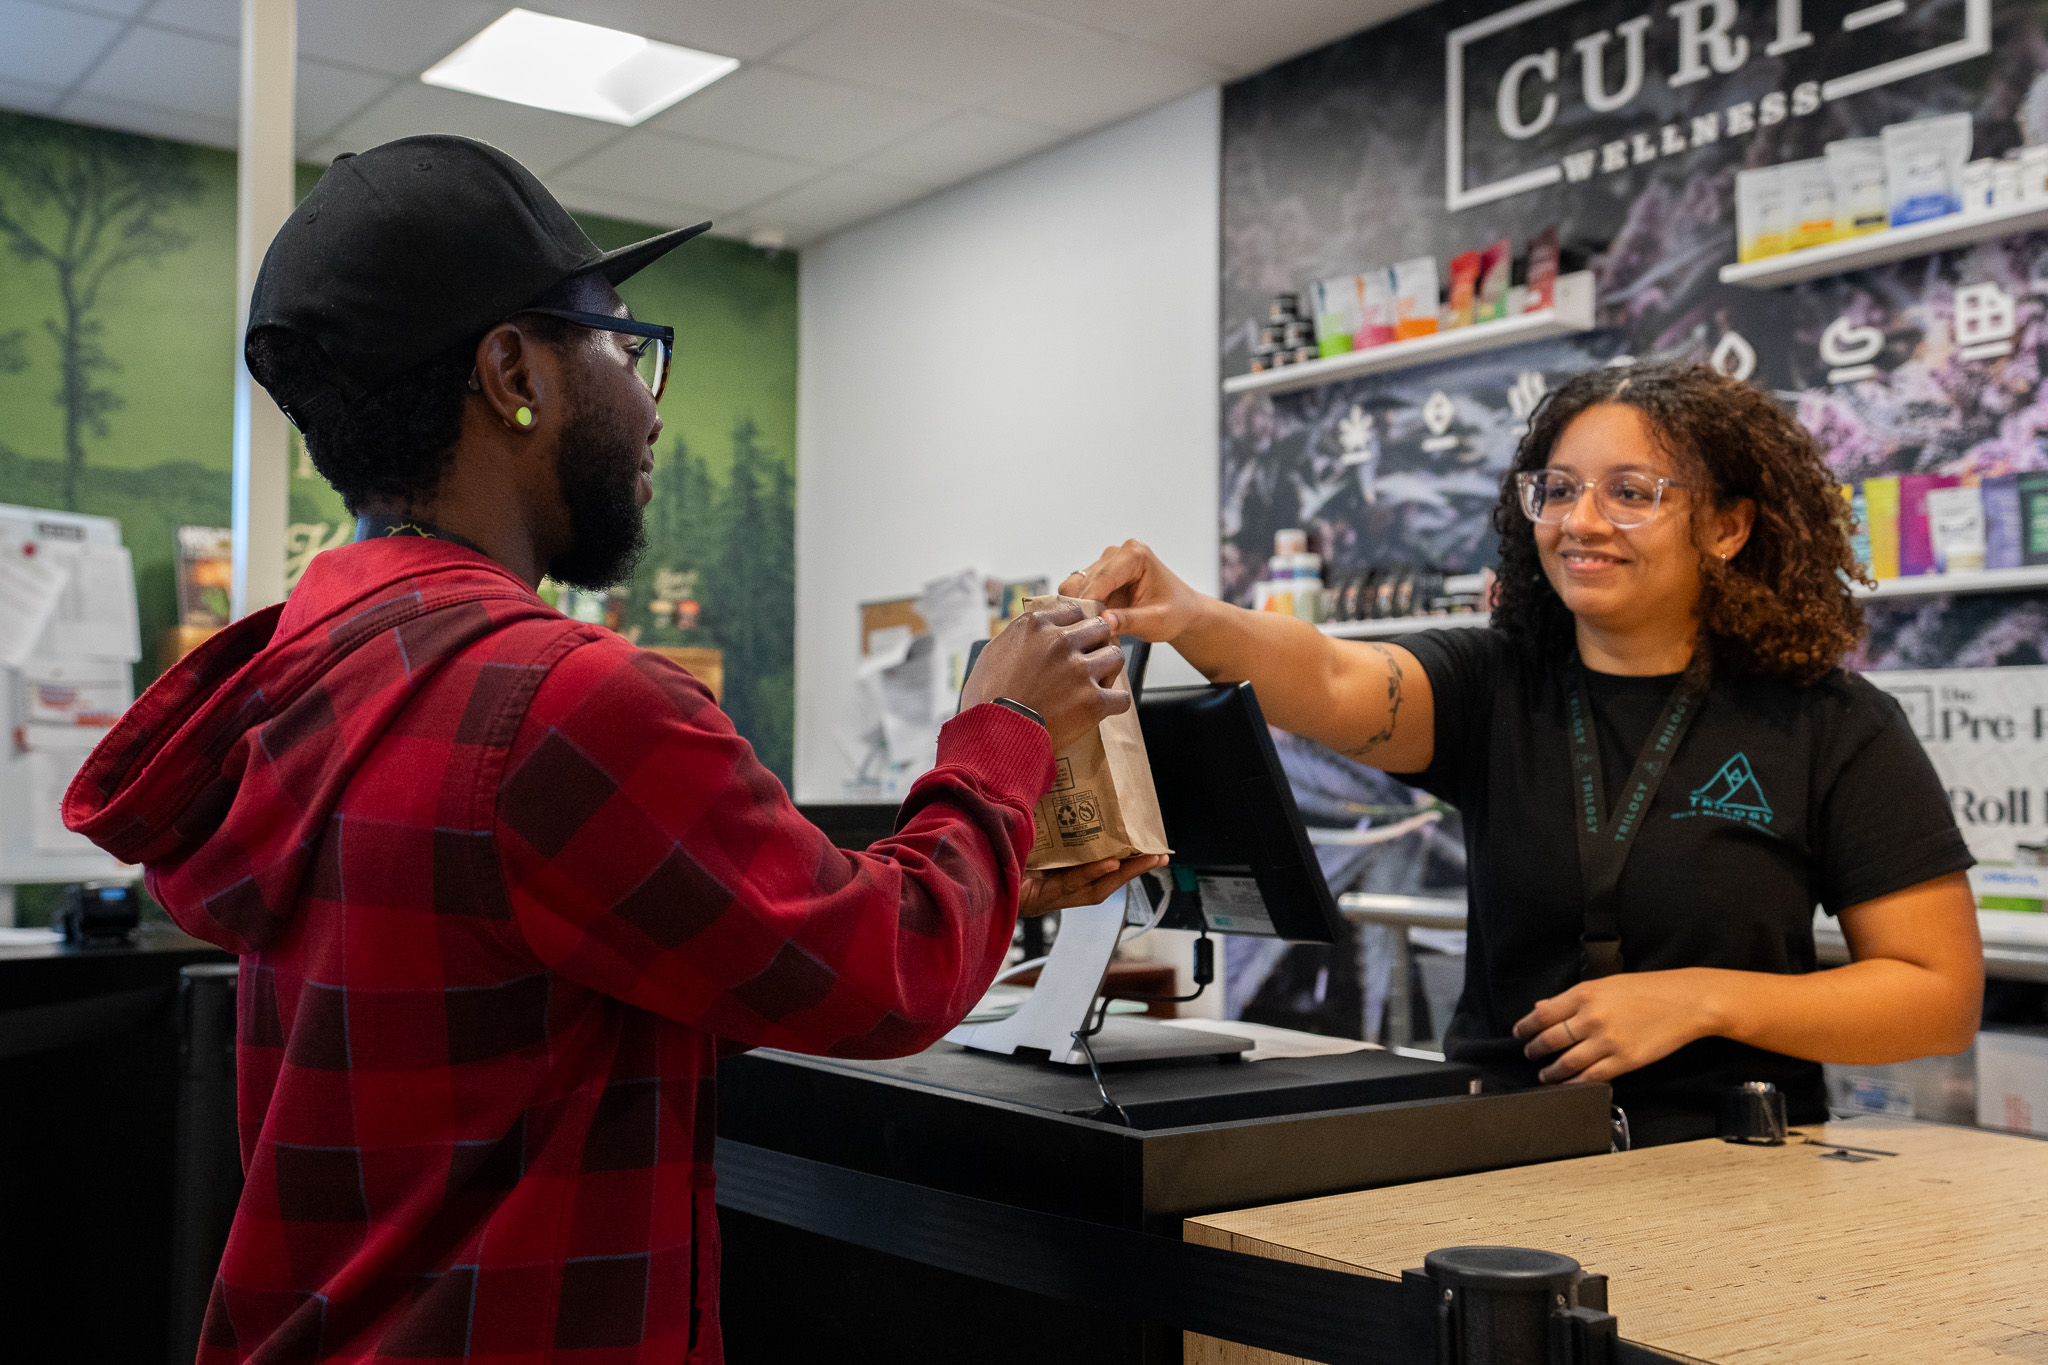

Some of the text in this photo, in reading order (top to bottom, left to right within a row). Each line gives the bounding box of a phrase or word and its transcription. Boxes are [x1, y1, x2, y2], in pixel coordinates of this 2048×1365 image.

[1562, 81, 1821, 184] WELLNESS
[1656, 695, 1690, 751] TRILOGY
[1582, 775, 1598, 833] TRILOGY
[1614, 782, 1648, 841] TRILOGY
[1949, 786, 2030, 825] Roll
